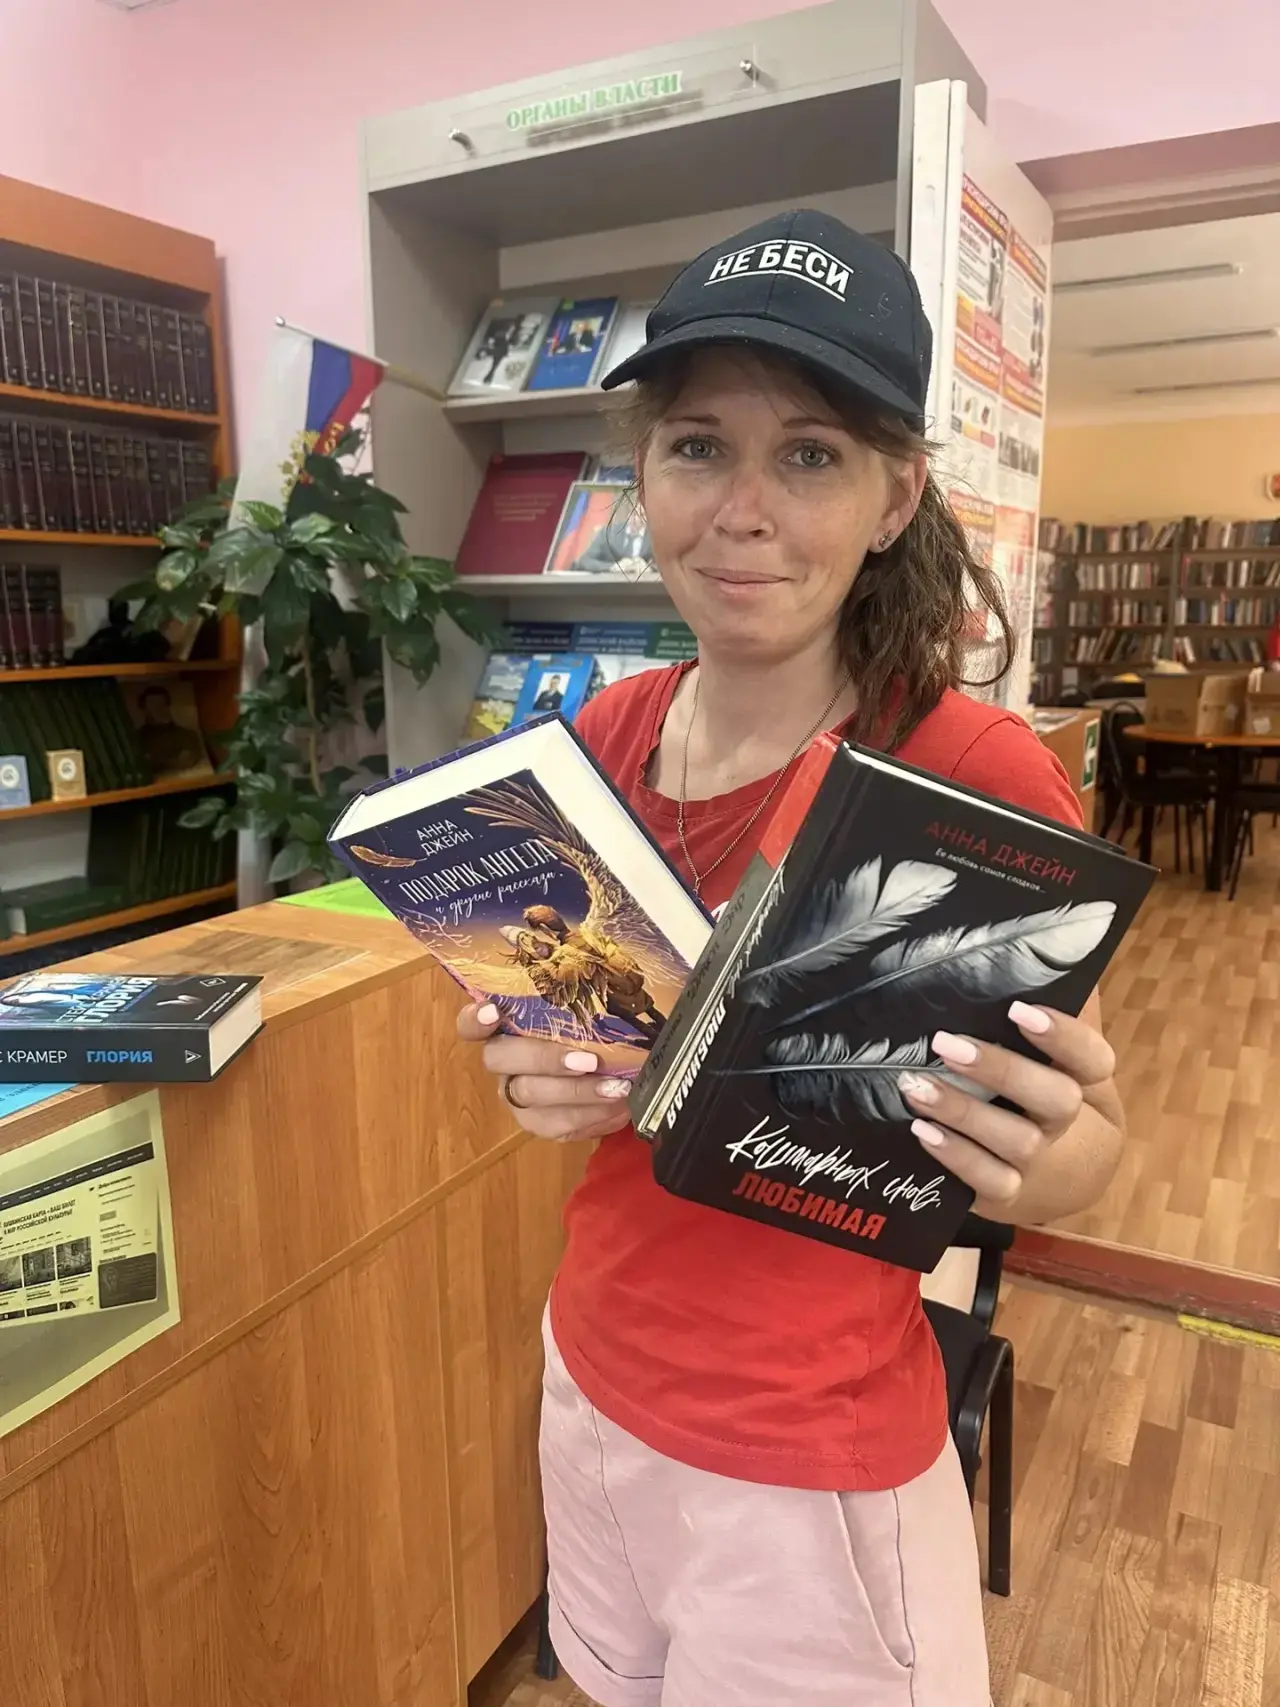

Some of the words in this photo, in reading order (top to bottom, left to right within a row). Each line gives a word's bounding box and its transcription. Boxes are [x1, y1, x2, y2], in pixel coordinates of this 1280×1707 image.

[507, 92, 589, 131] ОРГАНЫ
[594, 73, 681, 109] ВЛАСТИ
[709, 249, 756, 280] НЕ
[758, 244, 850, 294] БЕСИ
[416, 819, 459, 841] АННА
[420, 829, 474, 857] ДЖЕЙН
[924, 821, 988, 856] АННА
[990, 843, 1077, 887] ДЖЕЙН
[399, 861, 489, 904] ПОДАРОК
[480, 838, 559, 880] АНГЕЛА
[450, 889, 492, 926] другие
[72, 977, 158, 1023] ГЛОРИЯ
[7, 1050, 68, 1063] КРАМЕР
[86, 1050, 153, 1063] ГЛОРИЯ
[666, 996, 727, 1130] ЛЮБИМАЯ
[725, 1115, 889, 1199] Кошмарных
[732, 1171, 887, 1240] ЛЮБИМАЯ
